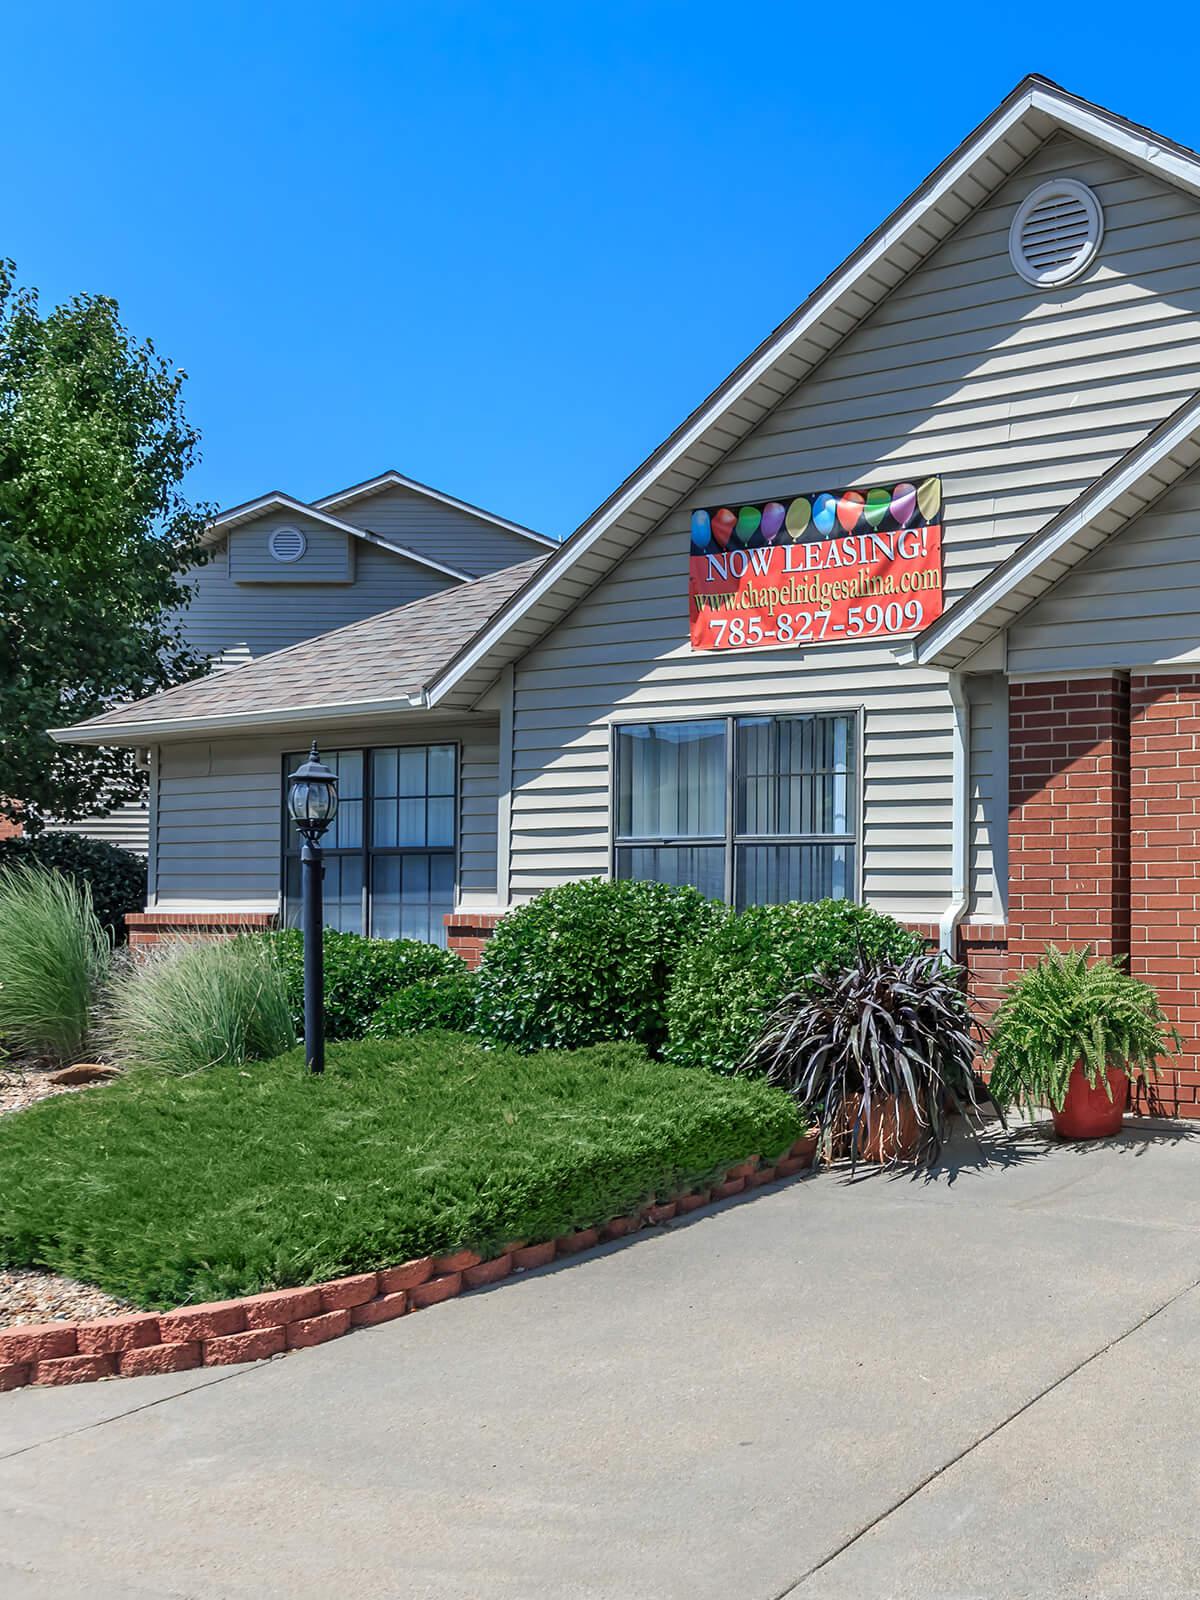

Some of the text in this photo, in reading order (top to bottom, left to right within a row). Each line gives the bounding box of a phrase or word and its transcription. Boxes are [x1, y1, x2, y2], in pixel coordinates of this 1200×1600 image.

[706, 527, 928, 582] NOW LEASING!
[694, 567, 941, 616] www.chapelridgesalina.com
[709, 599, 924, 648] 785-827-5909
